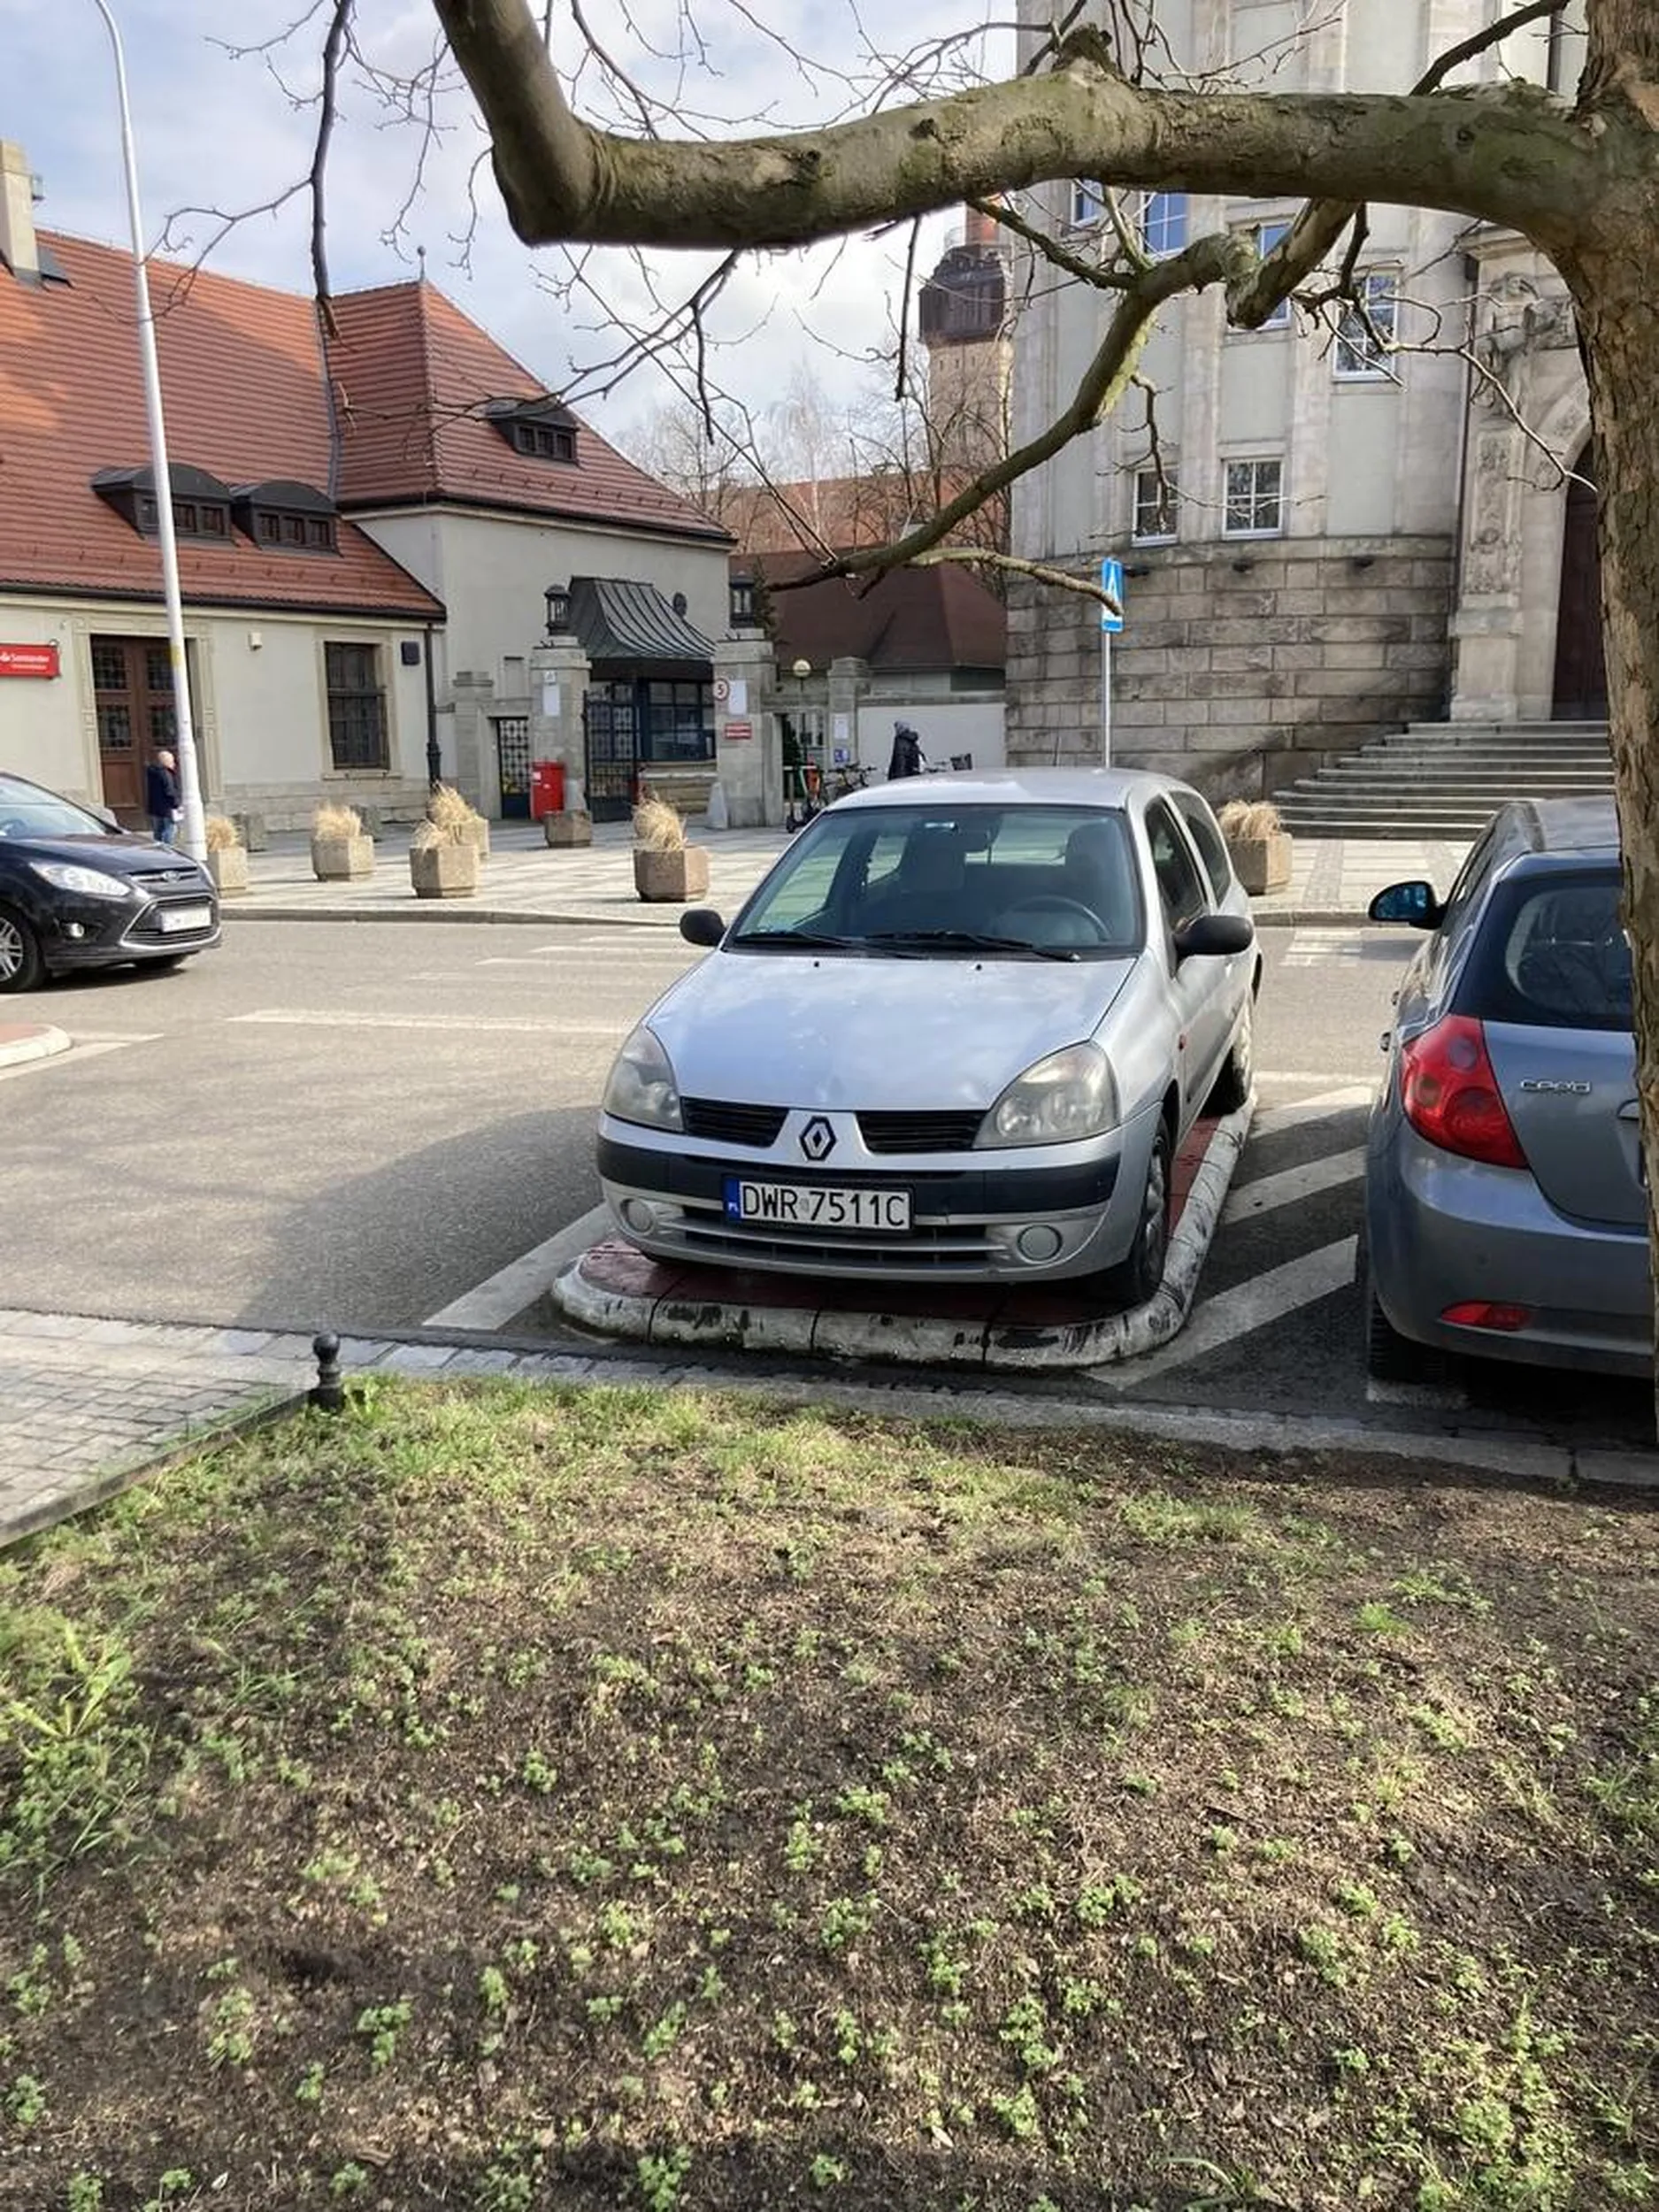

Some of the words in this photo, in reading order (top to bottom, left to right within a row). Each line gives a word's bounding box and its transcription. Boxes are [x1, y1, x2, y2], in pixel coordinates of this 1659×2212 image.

[718, 683, 725, 695] 5
[742, 1185, 798, 1220] DWR
[809, 1191, 904, 1226] 7511C
